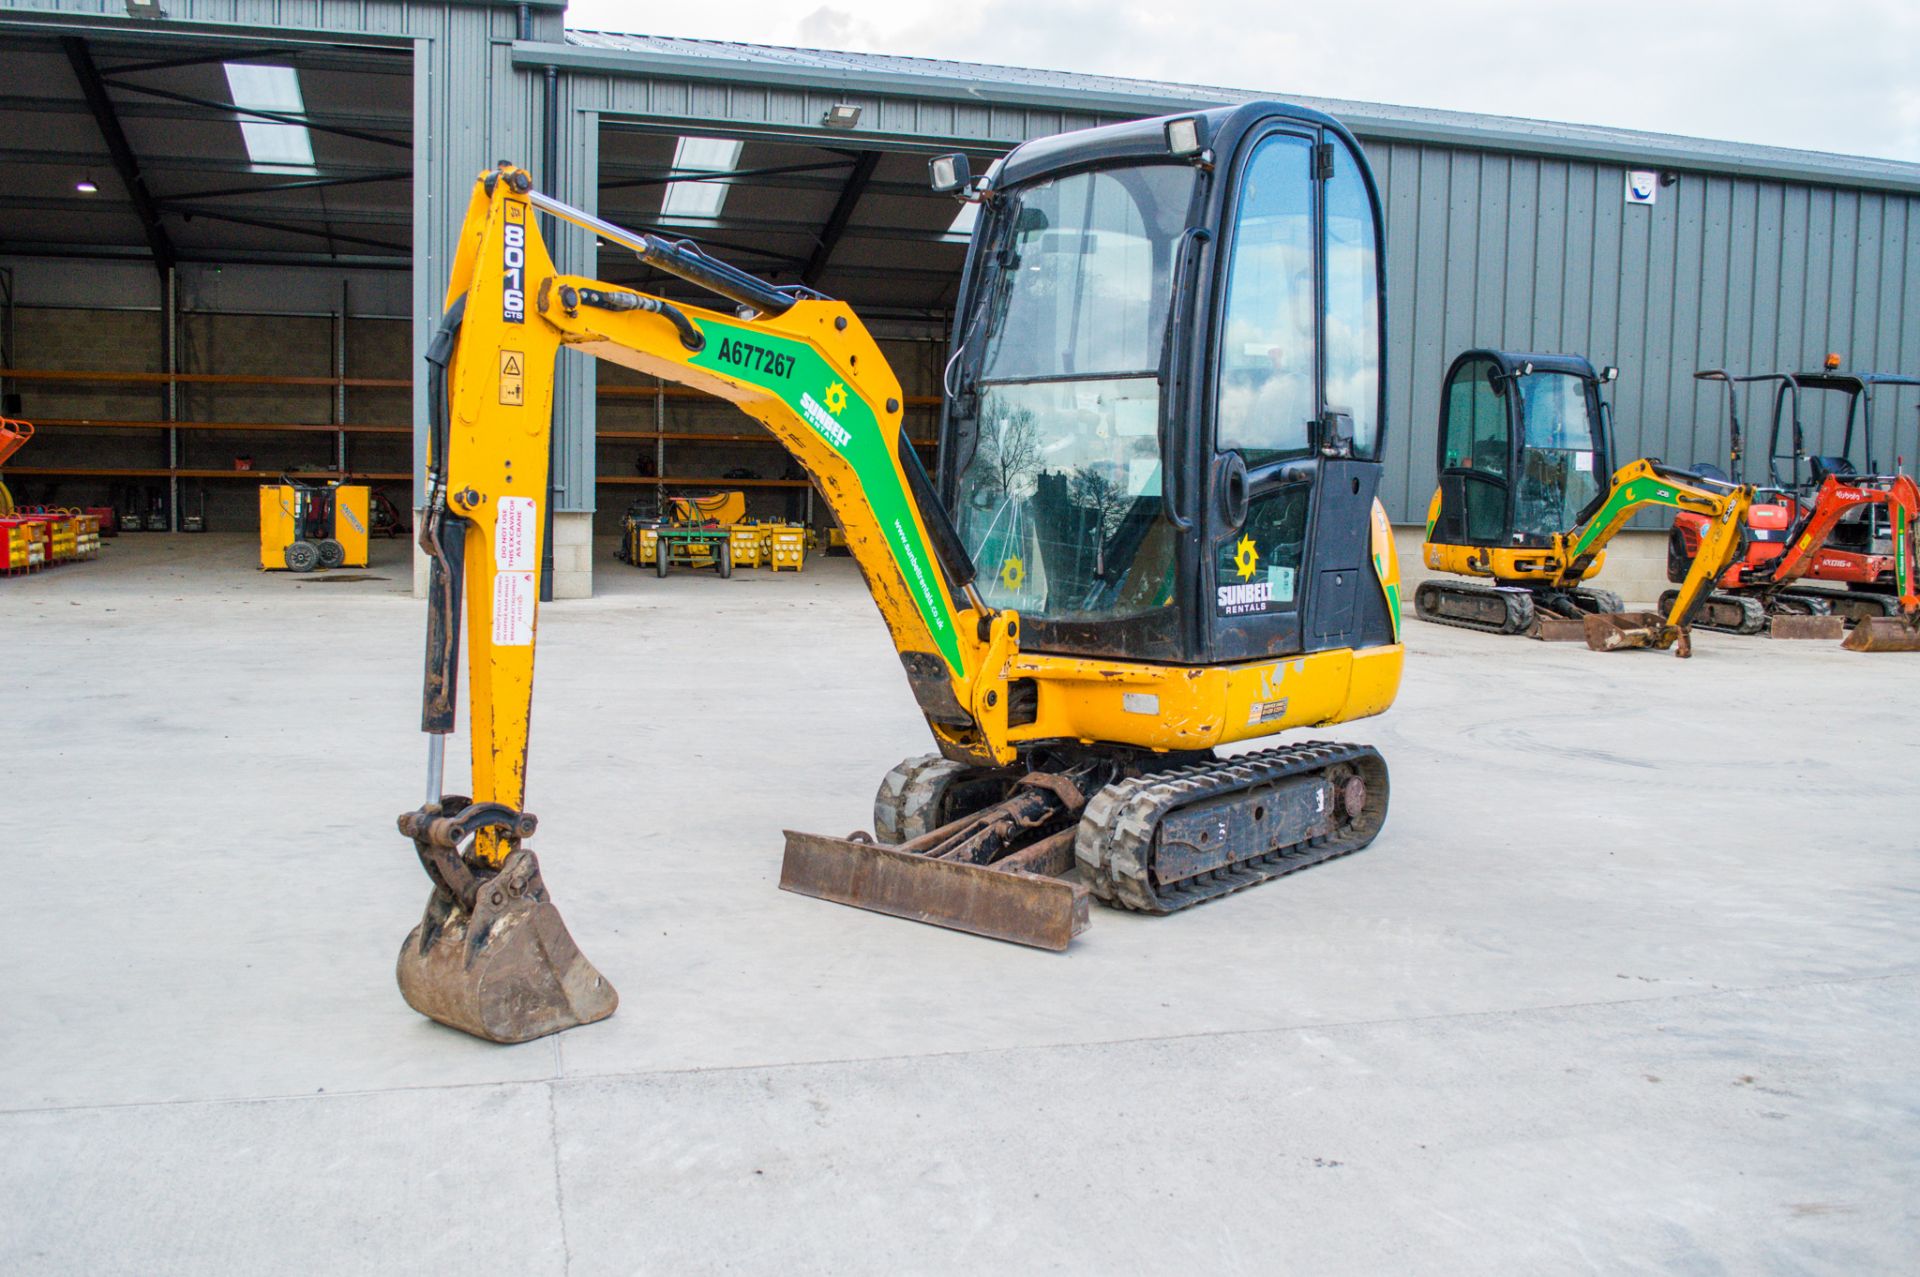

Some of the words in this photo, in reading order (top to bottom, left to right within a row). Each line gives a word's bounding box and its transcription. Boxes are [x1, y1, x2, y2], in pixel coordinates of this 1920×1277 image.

[504, 225, 524, 312] 8016
[718, 338, 796, 380] A677267
[800, 392, 852, 447] SUNBELT
[804, 410, 840, 447] RENTALS
[1836, 490, 1860, 501] Kubota
[501, 545, 508, 559] DO
[1217, 582, 1274, 607] SUNBELT
[1226, 602, 1267, 615] RENTALS
